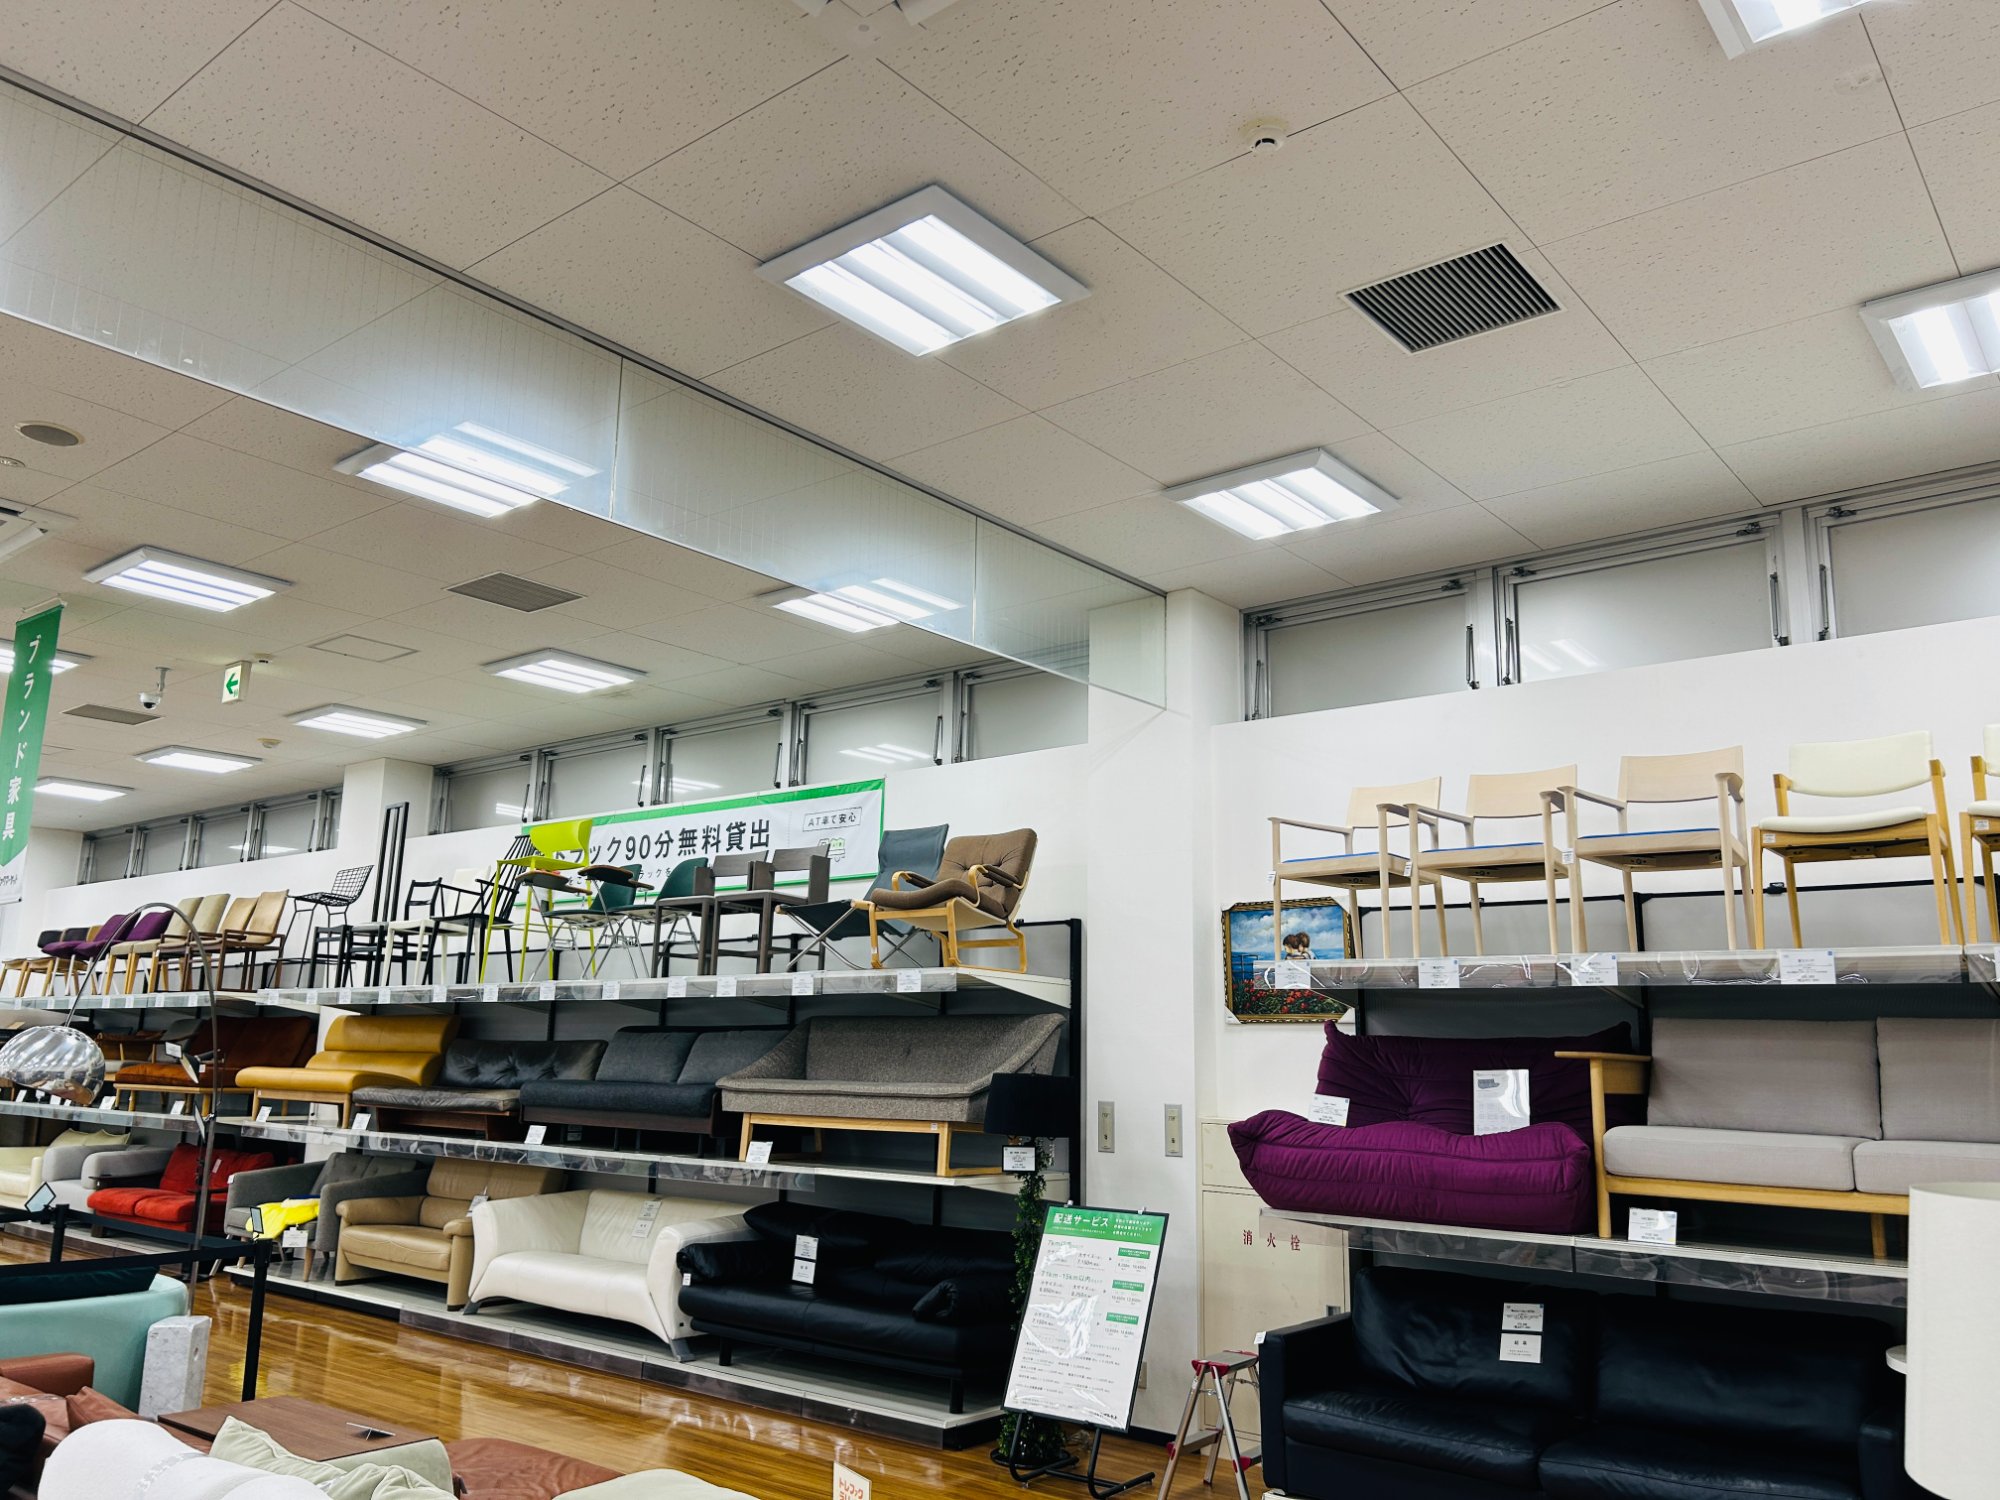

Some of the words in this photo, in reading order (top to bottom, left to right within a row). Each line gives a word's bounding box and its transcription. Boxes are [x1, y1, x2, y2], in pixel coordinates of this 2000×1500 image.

[2, 634, 42, 840] ブランド家具
[538, 818, 771, 864] トラック90分無料貸出
[1053, 1213, 1109, 1227] 配送サービス
[1243, 1229, 1301, 1251] 消火栓
